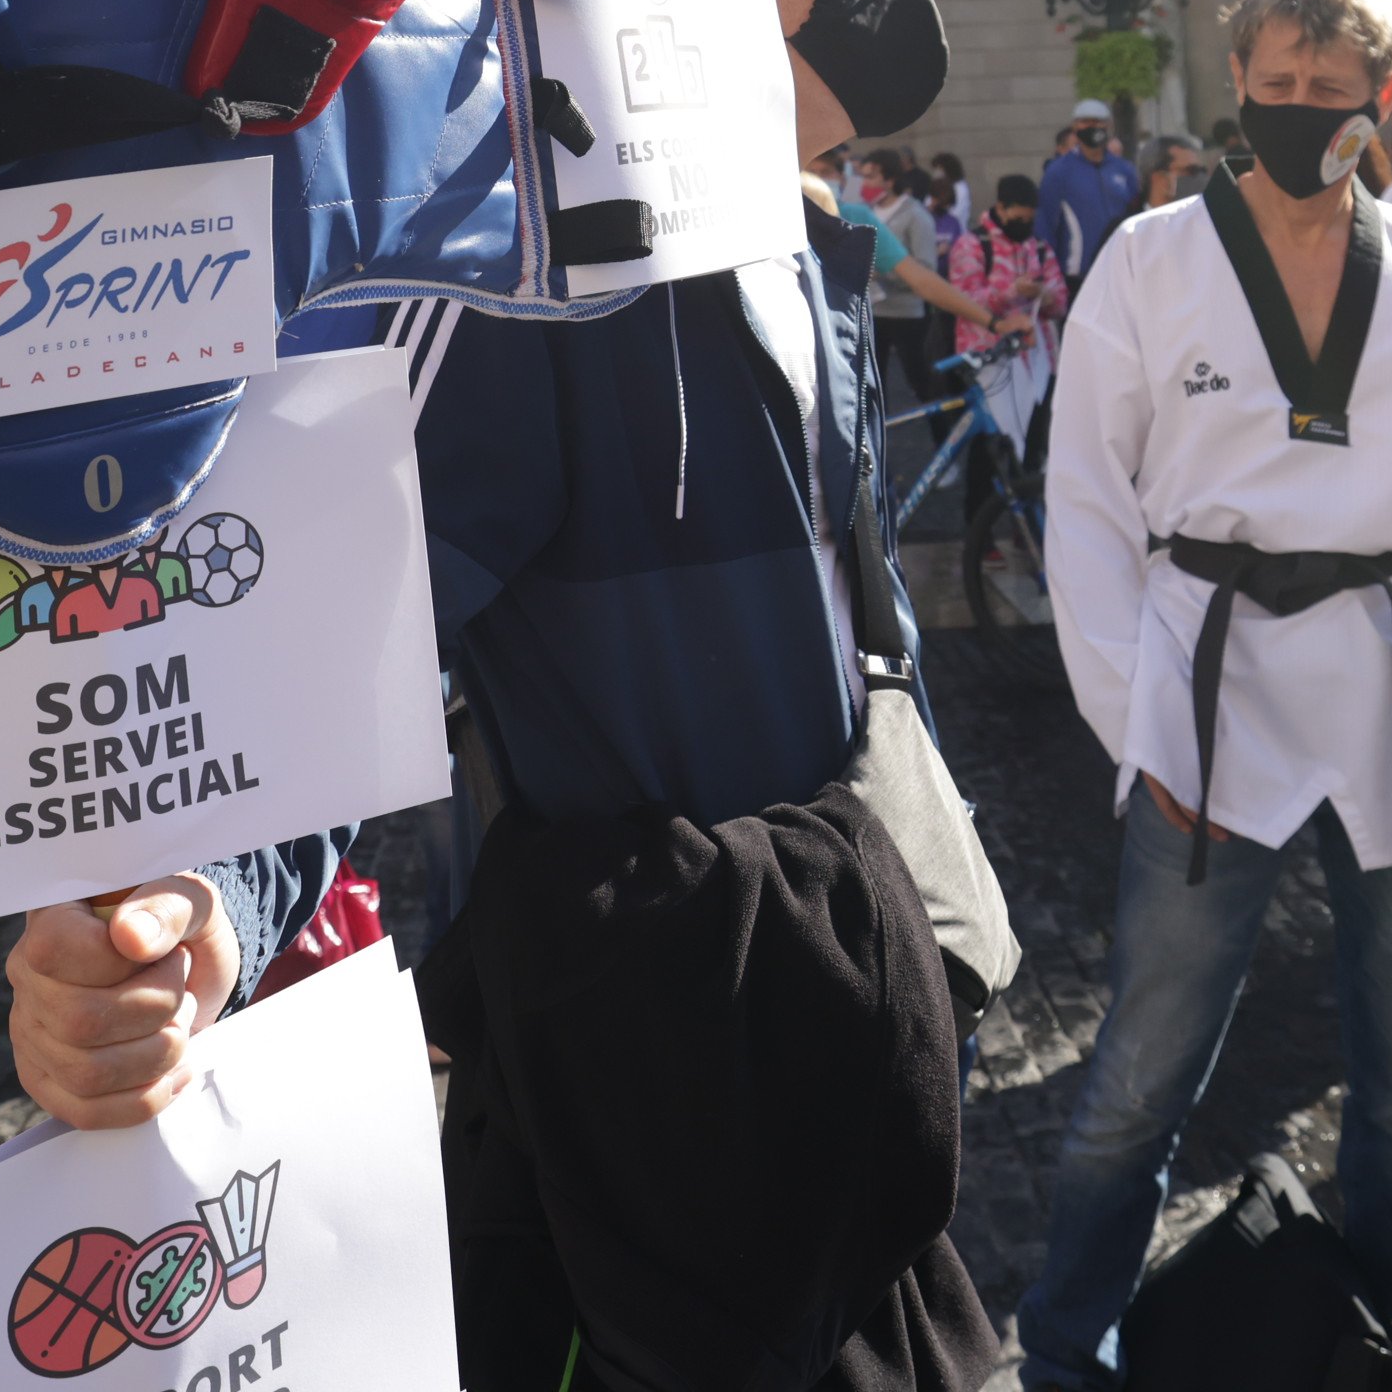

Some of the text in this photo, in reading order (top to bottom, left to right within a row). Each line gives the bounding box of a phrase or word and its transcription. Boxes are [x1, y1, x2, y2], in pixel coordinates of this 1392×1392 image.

[631, 43, 651, 83] 2
[615, 140, 655, 167] ELS
[101, 215, 234, 246] GIMNASIO
[27, 329, 149, 356] DESDE 1988
[35, 653, 191, 735] SOM
[28, 711, 206, 789] SERVEI
